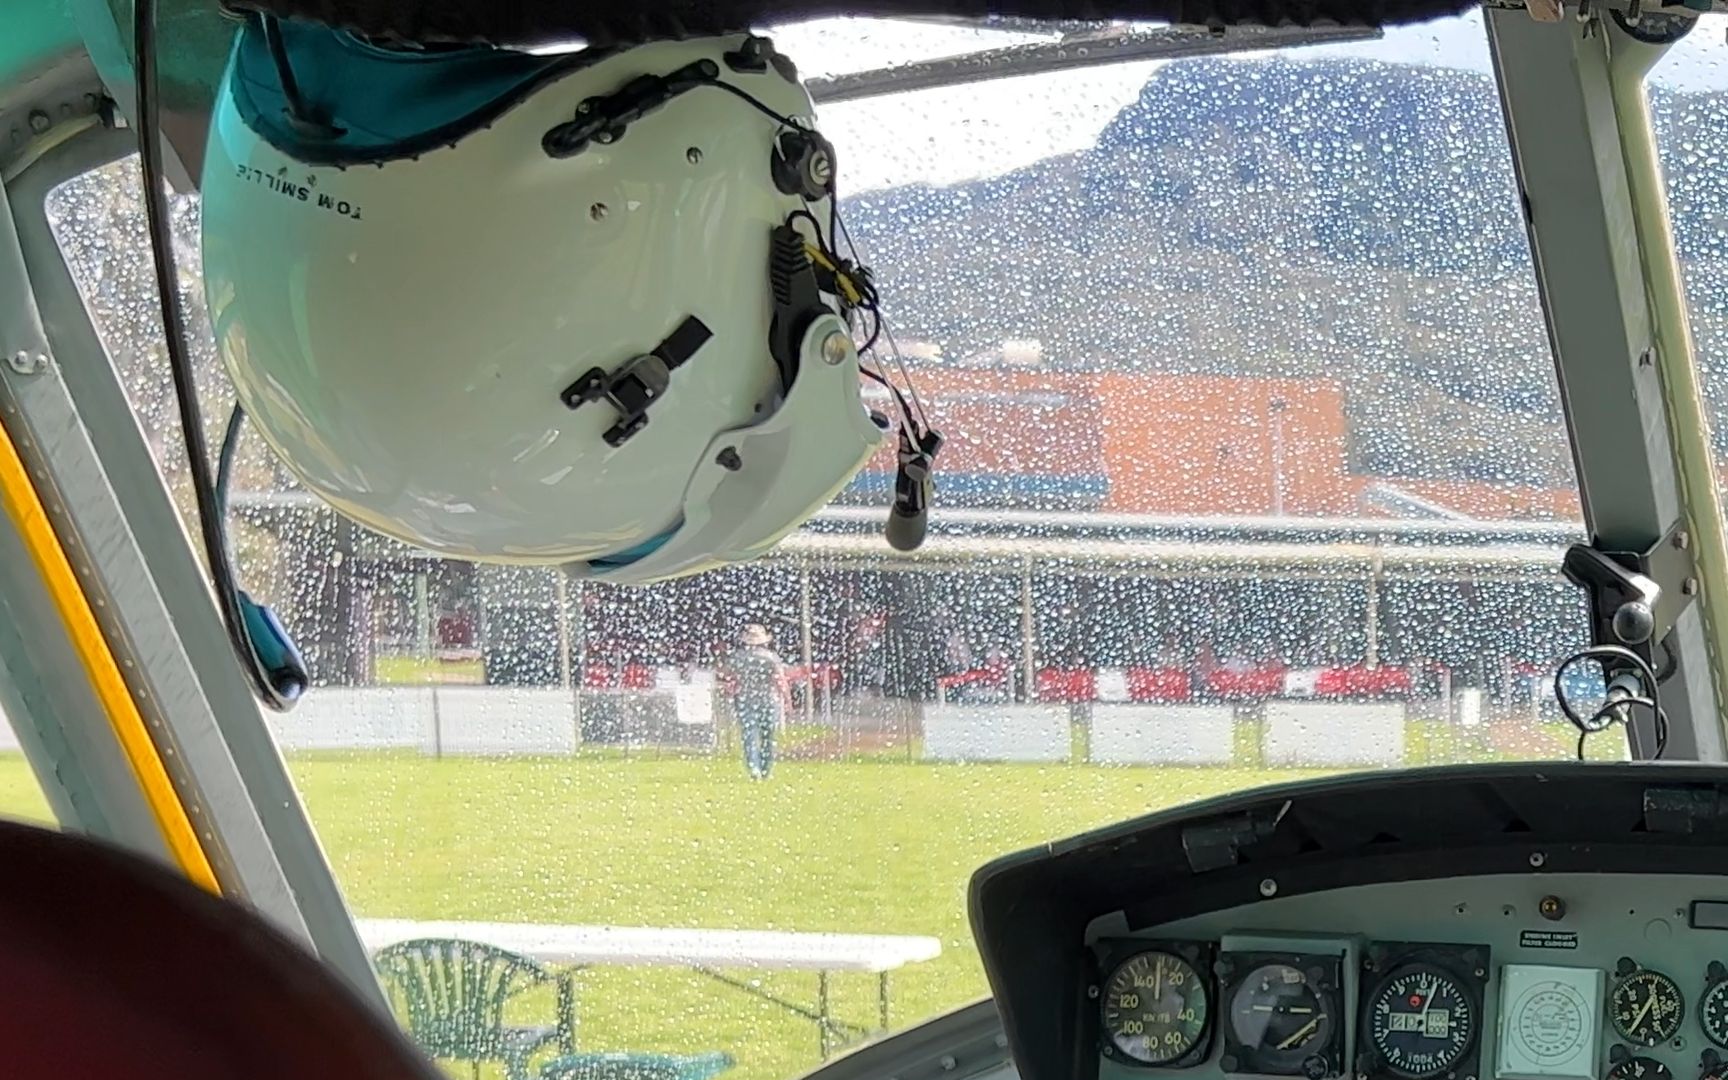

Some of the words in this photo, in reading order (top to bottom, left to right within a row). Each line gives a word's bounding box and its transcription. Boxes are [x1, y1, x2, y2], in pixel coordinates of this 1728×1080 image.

[318, 193, 361, 220] TOM
[1134, 975, 1154, 988] 140
[1168, 972, 1184, 985] 20
[1120, 994, 1139, 1009] 120
[1142, 1013, 1170, 1023] KNTS
[1177, 1008, 1195, 1021] 40
[1122, 1021, 1143, 1034] 100
[1142, 1036, 1159, 1049] 80
[1165, 1032, 1181, 1045] 60
